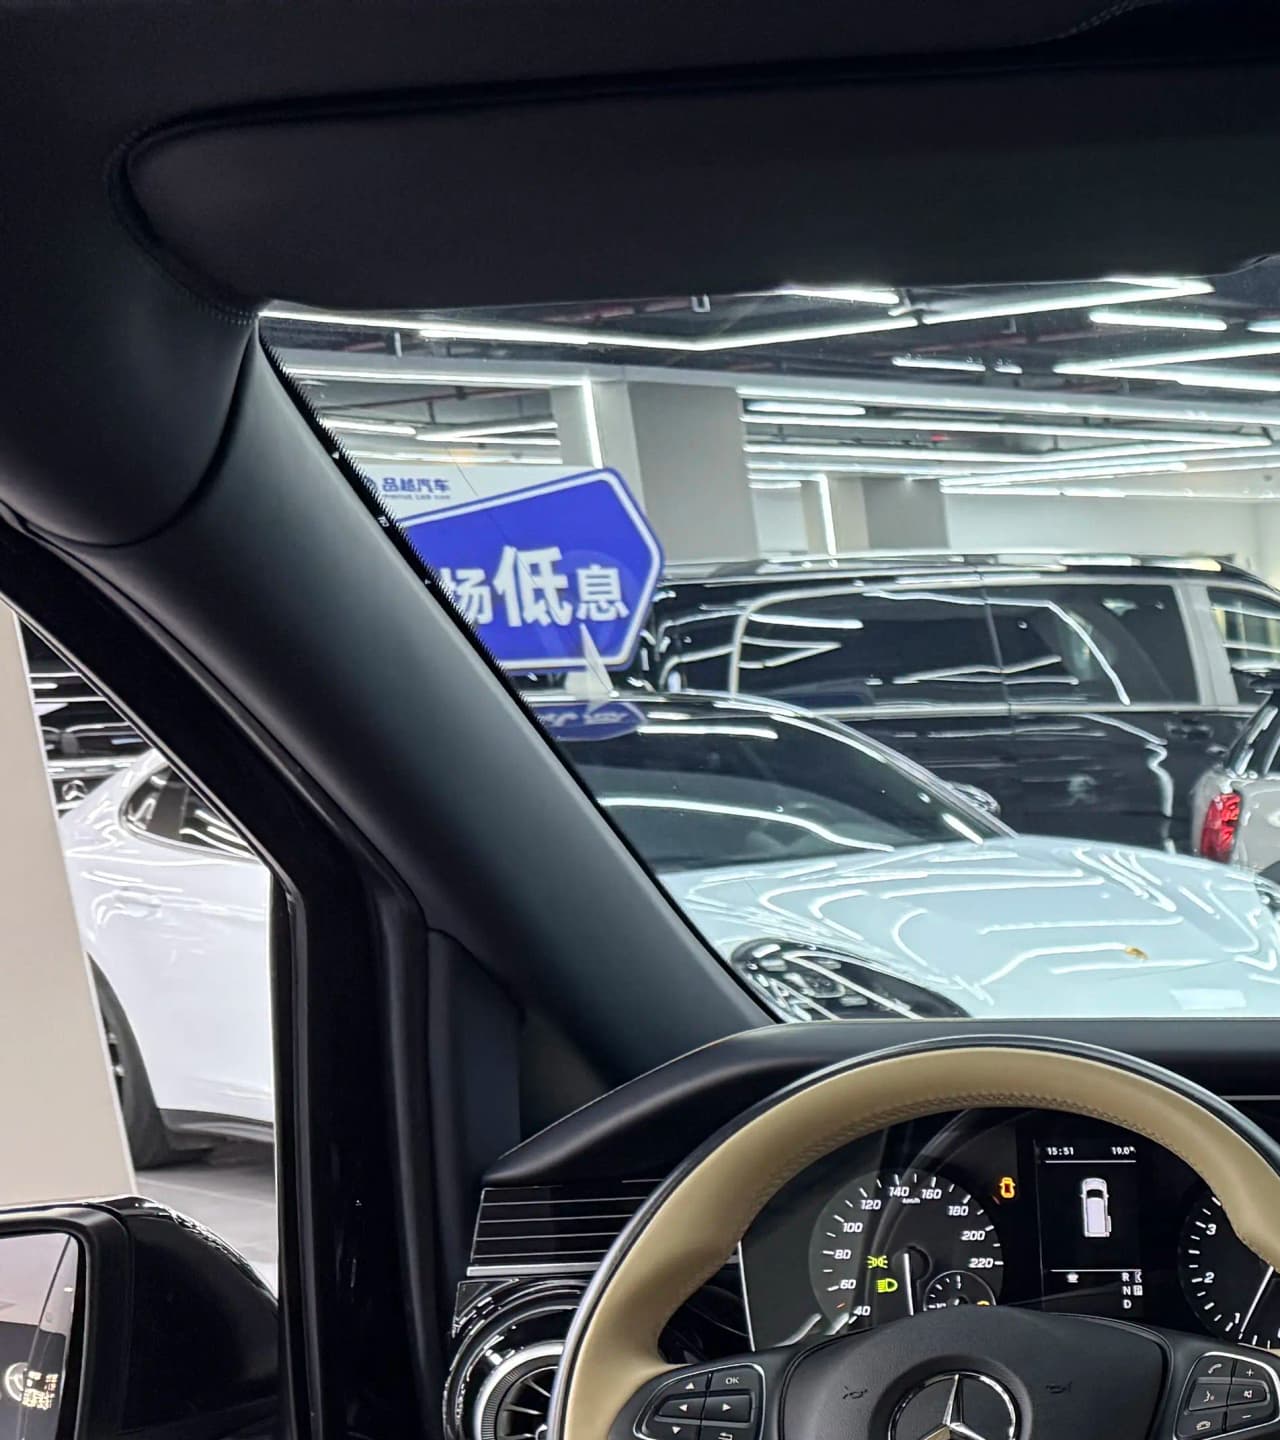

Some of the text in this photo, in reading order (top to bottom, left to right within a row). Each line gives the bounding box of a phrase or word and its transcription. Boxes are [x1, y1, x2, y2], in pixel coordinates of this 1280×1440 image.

[888, 1186, 910, 1197] 140
[921, 1189, 942, 1200] 160
[860, 1200, 881, 1210] 120
[947, 1206, 969, 1216] 180
[842, 1222, 863, 1232] 100
[1206, 1224, 1217, 1235] 3
[961, 1231, 986, 1241] 200
[834, 1250, 852, 1260] 80
[969, 1258, 994, 1269] 220
[1121, 1272, 1129, 1282] R
[1204, 1272, 1215, 1283] 2
[840, 1279, 856, 1289] 60
[1122, 1285, 1131, 1296] N
[1123, 1299, 1132, 1309] D
[853, 1305, 871, 1316] 40
[1234, 1312, 1241, 1324] 1
[725, 1376, 740, 1385] OK
